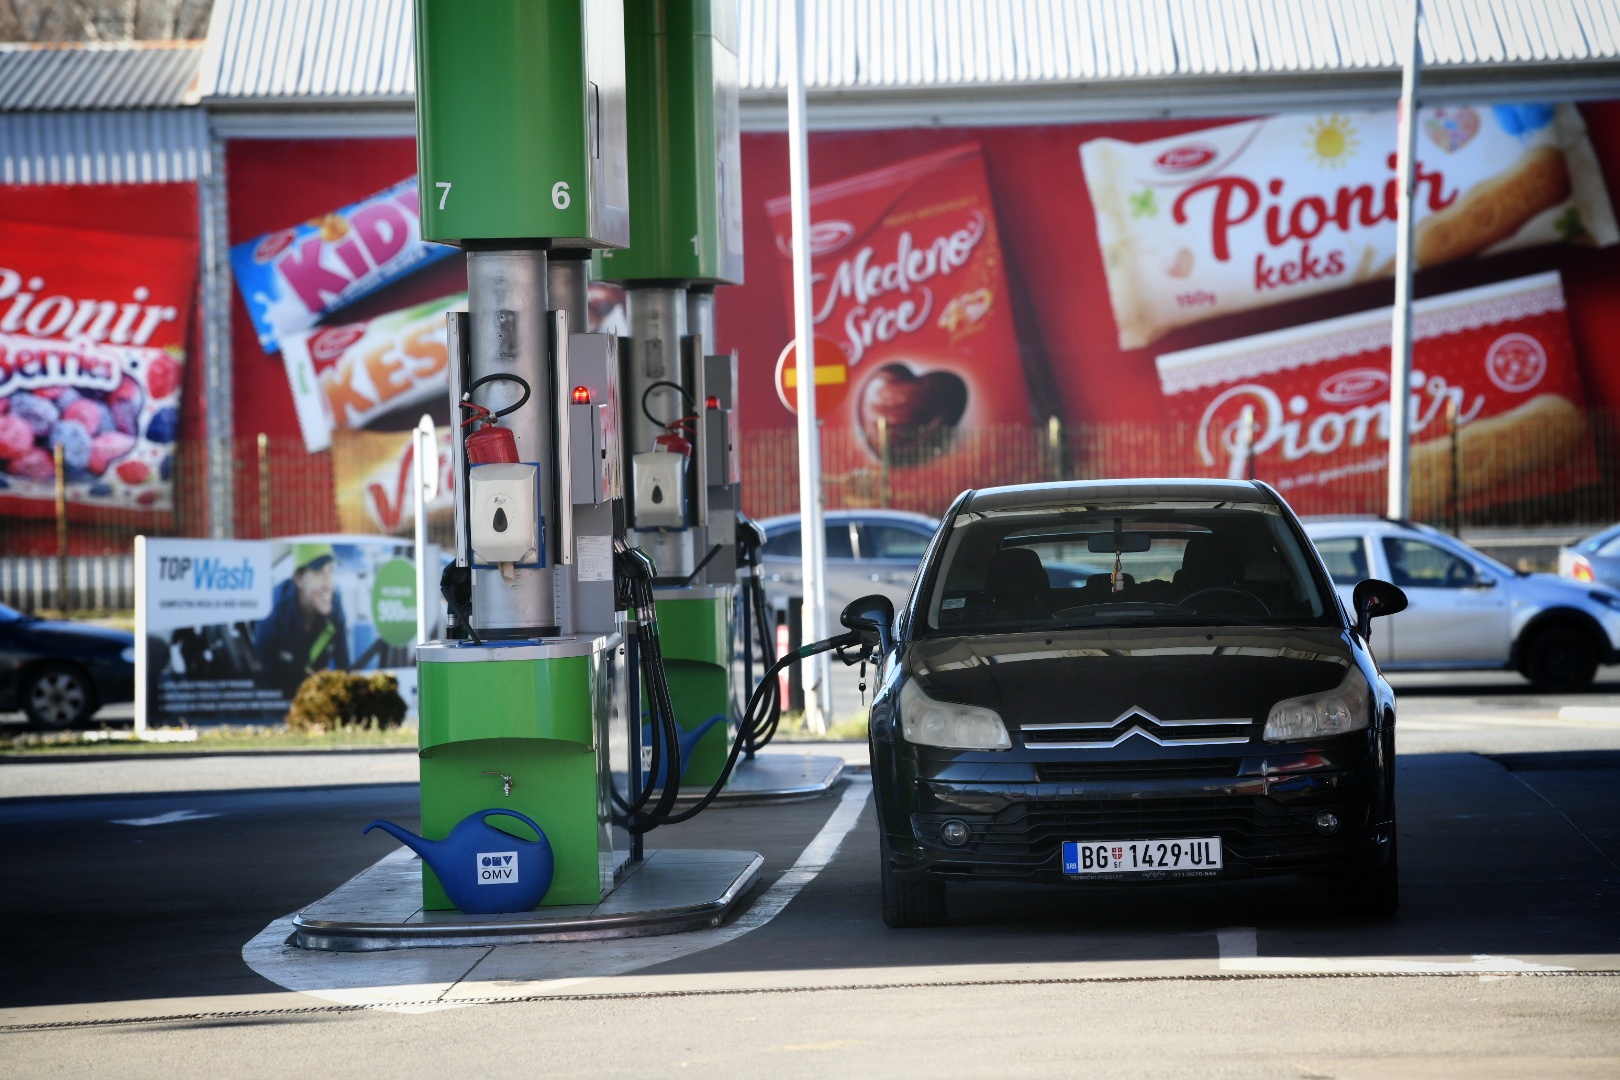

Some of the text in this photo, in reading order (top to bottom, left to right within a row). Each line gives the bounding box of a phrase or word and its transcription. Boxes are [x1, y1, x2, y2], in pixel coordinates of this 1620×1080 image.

[435, 182, 452, 210] 7
[551, 181, 571, 210] 6
[1172, 150, 1458, 262] Pionir
[690, 235, 700, 256] 1
[812, 210, 985, 324] Medeno
[1254, 244, 1346, 292] keks
[846, 286, 932, 366] Srce
[1198, 370, 1486, 480] Pionir
[482, 869, 513, 880] OMV
[1082, 846, 1108, 870] BG
